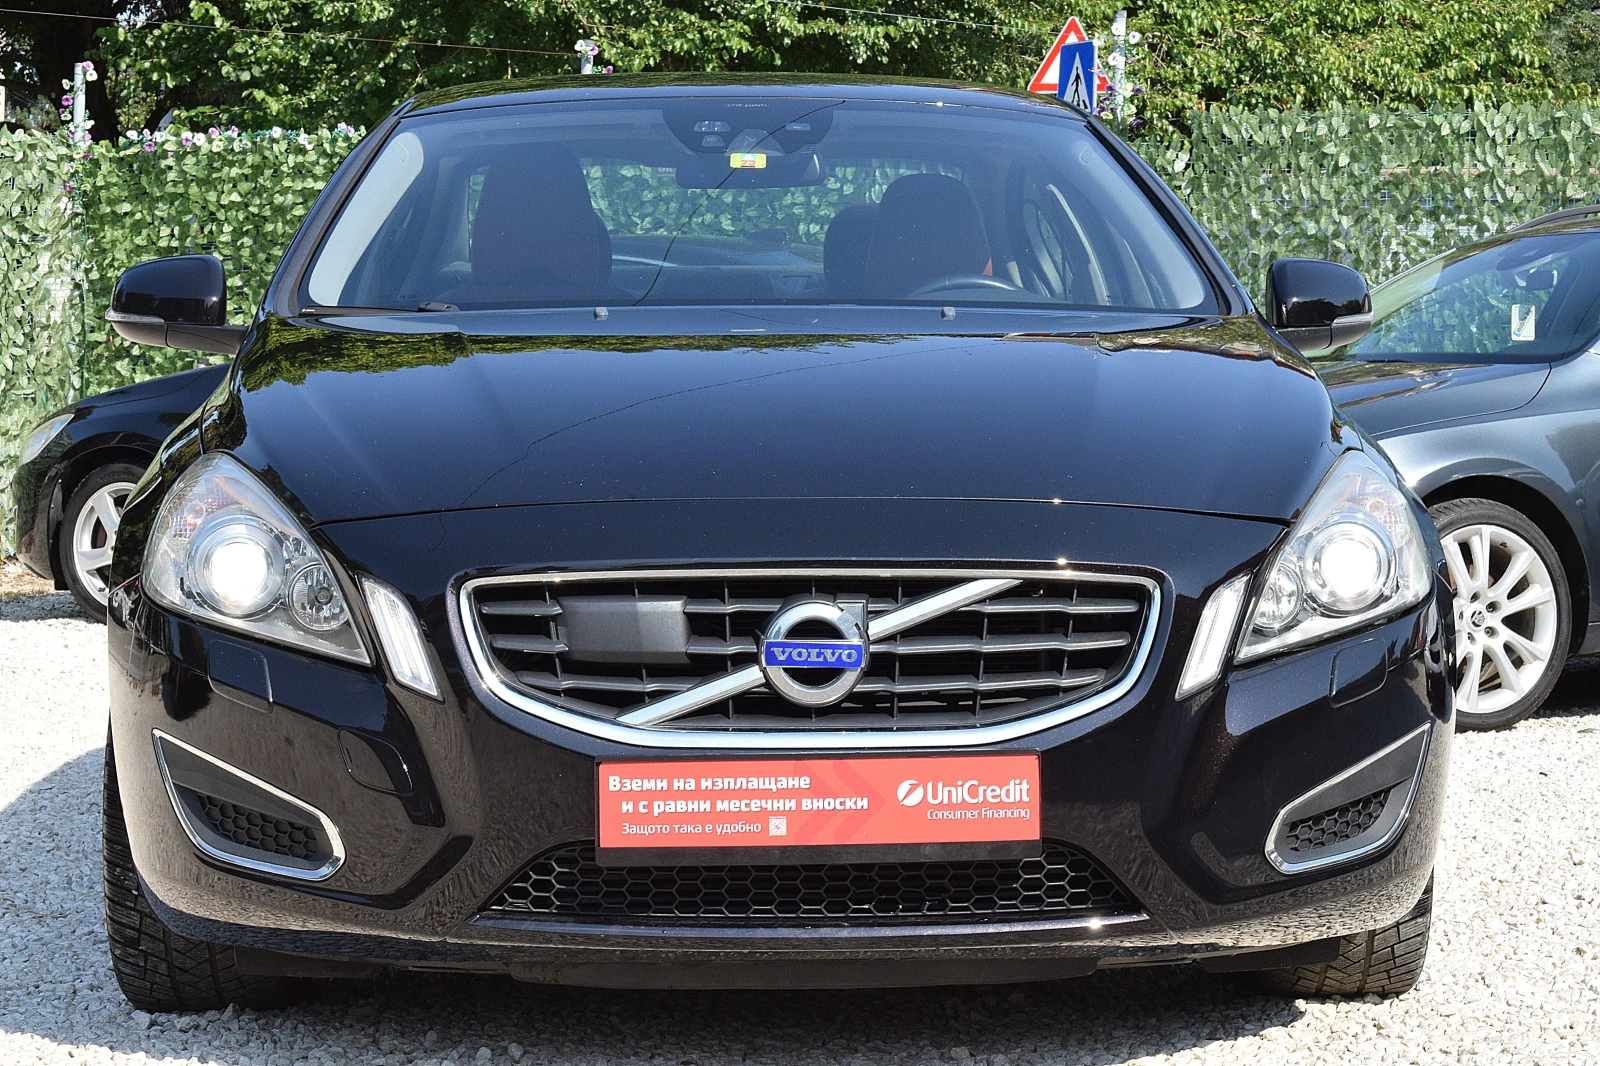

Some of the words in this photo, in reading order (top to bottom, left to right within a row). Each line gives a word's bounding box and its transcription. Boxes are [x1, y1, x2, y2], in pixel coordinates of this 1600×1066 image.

[771, 648, 858, 662] VOLVO
[608, 775, 668, 792] Вземи
[673, 778, 696, 791] на
[701, 776, 811, 793] изплащане
[927, 778, 1030, 805] UniCredit
[621, 801, 634, 813] и
[638, 800, 649, 813] с
[653, 799, 711, 816] равни
[716, 798, 797, 813] месечни
[801, 796, 869, 811] вноски
[927, 808, 980, 820] Consumer
[981, 807, 1030, 821] Financing
[621, 822, 670, 836] Защото
[673, 823, 702, 834] така
[705, 823, 713, 833] е
[716, 820, 762, 836] удобно
